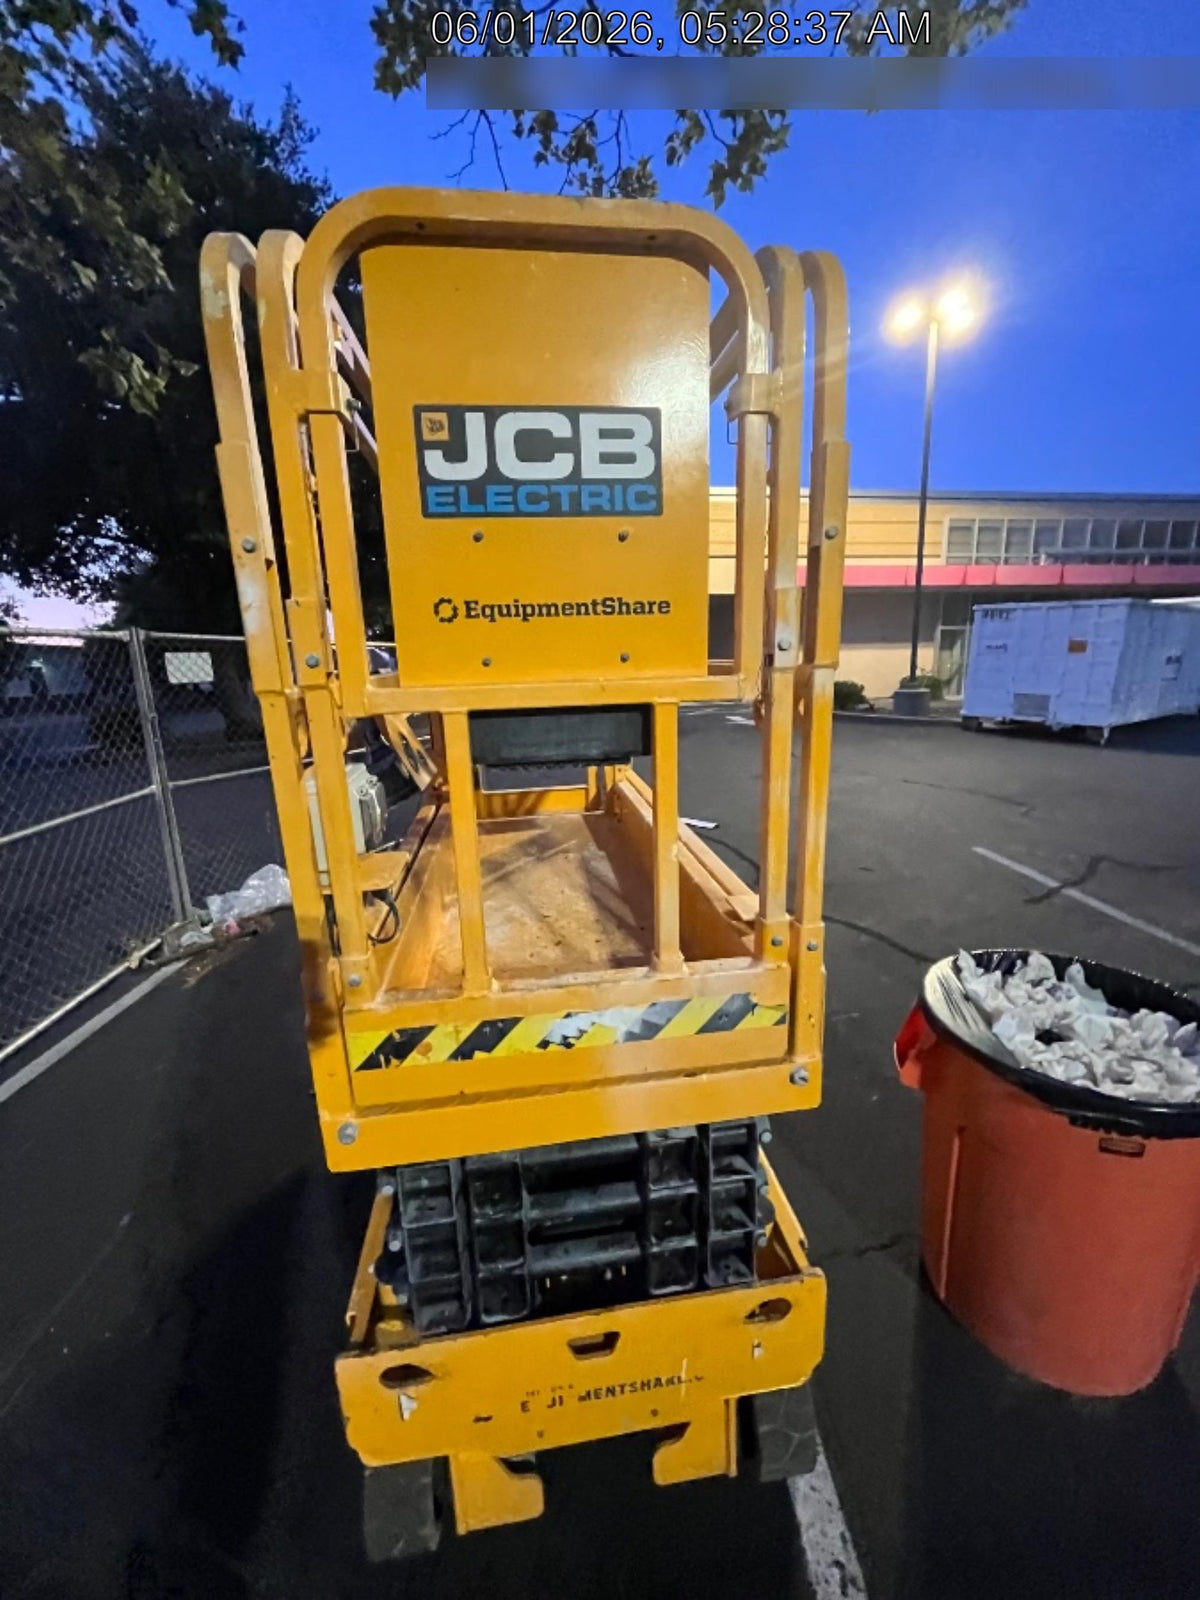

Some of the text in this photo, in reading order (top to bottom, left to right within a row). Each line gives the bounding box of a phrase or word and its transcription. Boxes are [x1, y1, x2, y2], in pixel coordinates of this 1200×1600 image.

[423, 411, 656, 481] JCB
[426, 484, 658, 513] ELECTRIC
[464, 596, 671, 622] EquipmentShare
